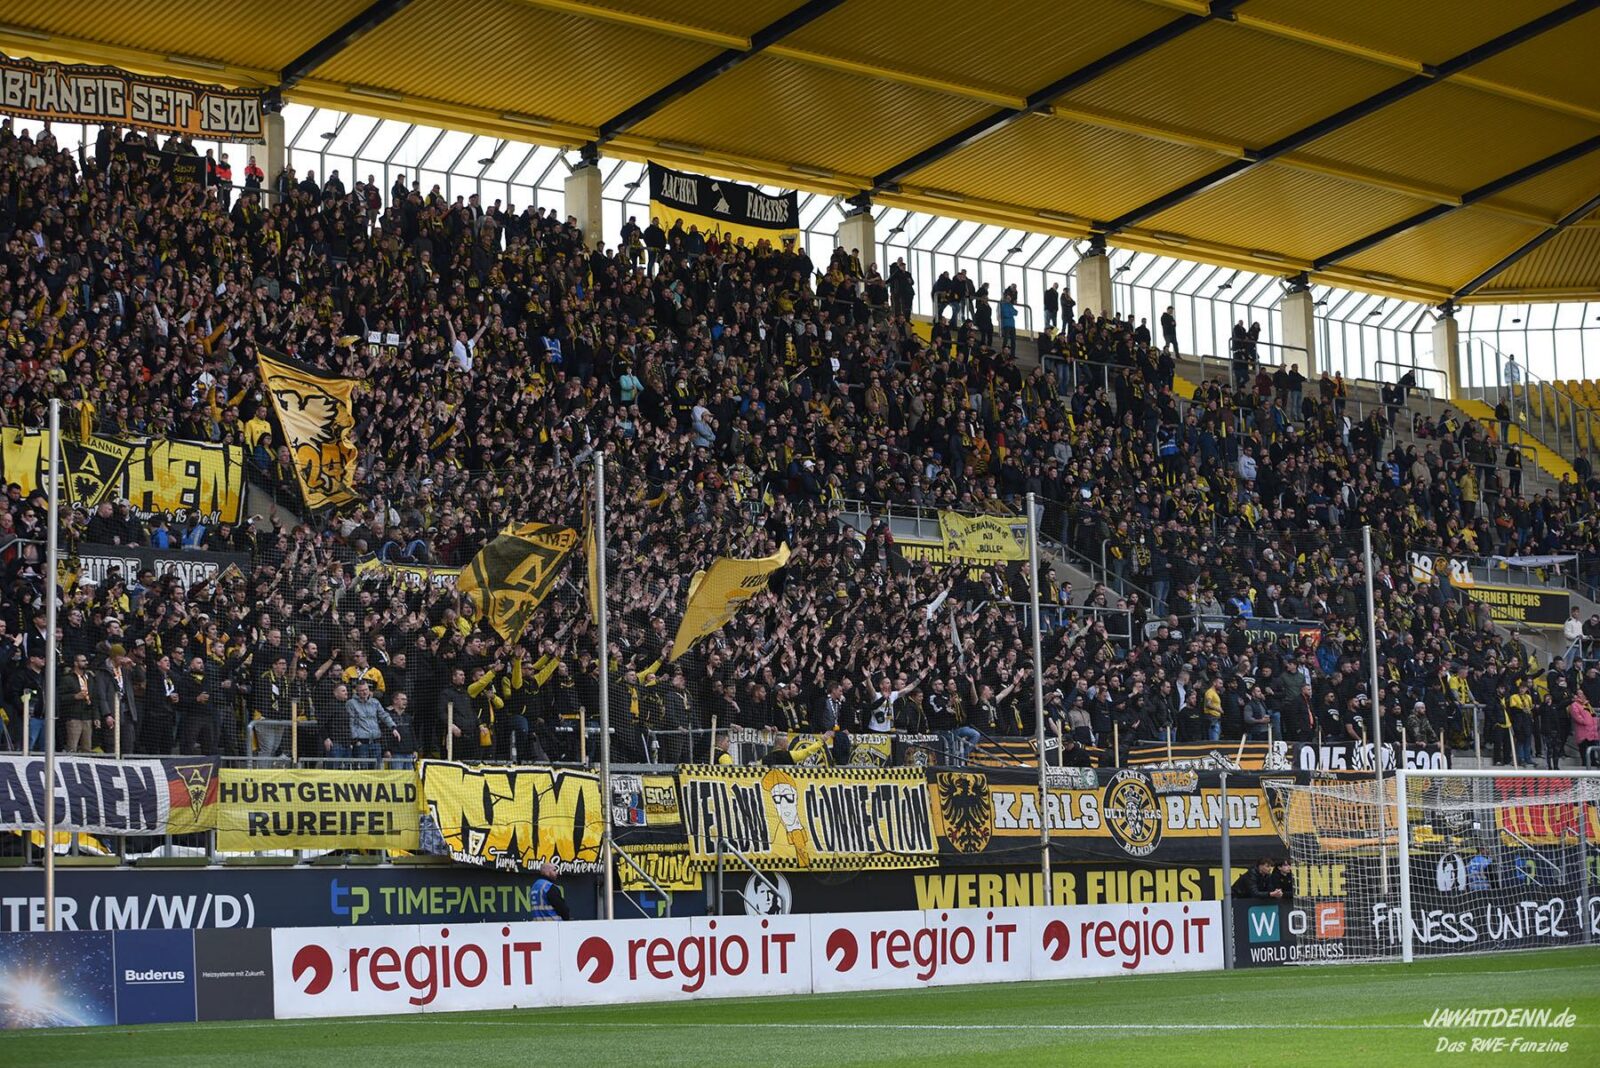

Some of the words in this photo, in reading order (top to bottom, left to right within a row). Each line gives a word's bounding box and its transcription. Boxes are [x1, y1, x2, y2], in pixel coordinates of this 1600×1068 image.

[0, 68, 125, 115] BHÄNGIG
[132, 85, 193, 127] SEIT
[200, 95, 259, 132] 1900
[661, 172, 698, 206] AACHEN
[902, 545, 955, 563] WERNE
[1468, 590, 1508, 605] WERNER
[1509, 592, 1540, 607] FUCHS
[1488, 606, 1526, 620] RIBÜNE
[219, 778, 417, 803] HÜRTGENWALD
[249, 811, 401, 837] RUREIFEL
[683, 781, 770, 854] YELLOW
[805, 784, 933, 852] CONNECTION
[992, 793, 1101, 829] KARLS
[1167, 795, 1261, 829] BANDE
[380, 886, 564, 915] TIMEPARTN
[1087, 867, 1202, 904] FUCHS
[89, 893, 256, 930] (M/W/D)
[1486, 897, 1569, 940] UNTER
[870, 912, 975, 981] regio
[1080, 906, 1174, 969] regio
[1250, 946, 1286, 962] WORLD
[1290, 945, 1302, 959] OF
[1305, 942, 1344, 959] FITNESS
[349, 928, 488, 1006] regio
[627, 920, 749, 993] regio
[125, 969, 185, 982] Buderus
